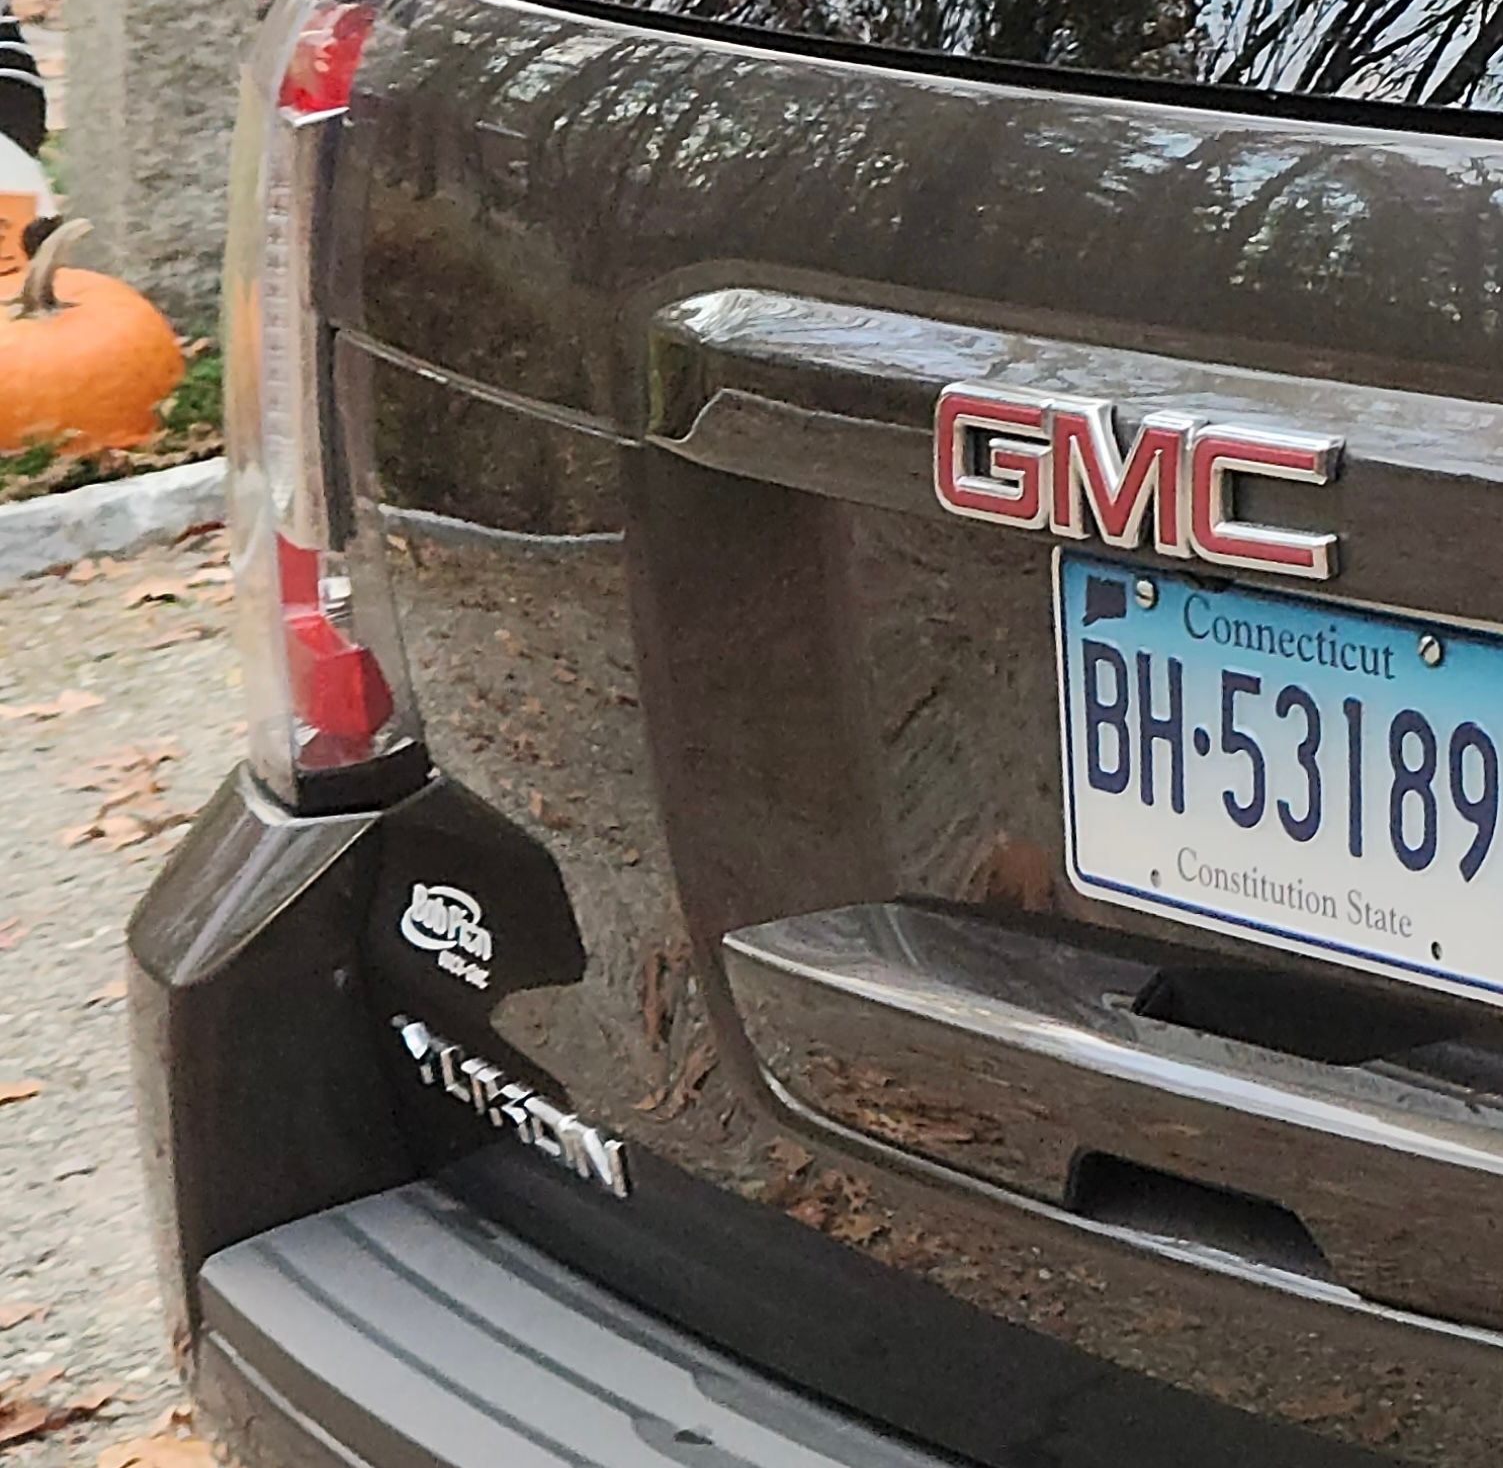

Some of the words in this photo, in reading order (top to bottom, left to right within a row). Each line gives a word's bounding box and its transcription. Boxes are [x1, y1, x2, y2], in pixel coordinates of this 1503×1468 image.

[932, 378, 1347, 580] GMC
[1183, 593, 1396, 681] Connecticut
[1177, 846, 1338, 920] Constitution
[1347, 891, 1414, 940] State
